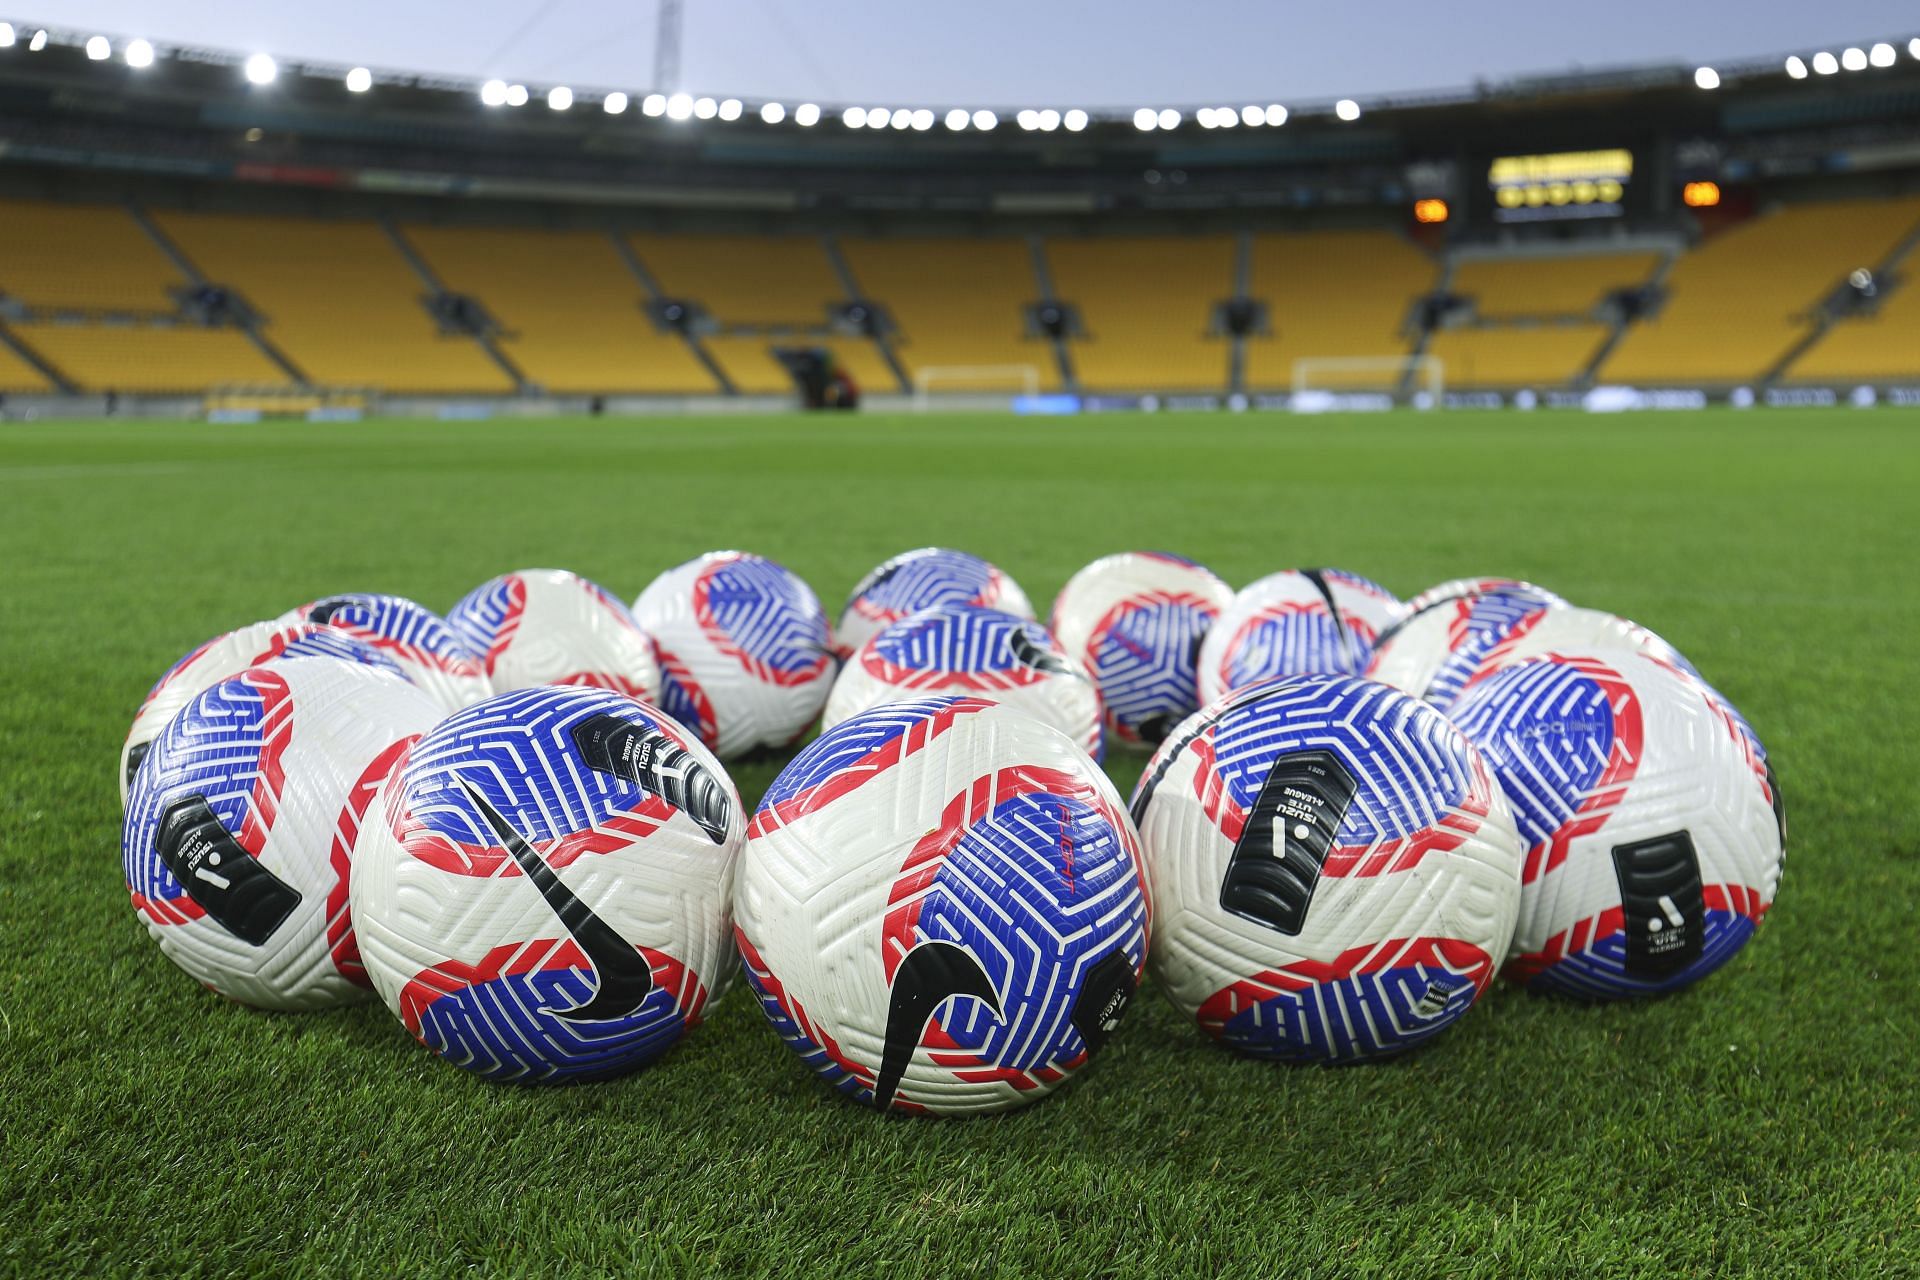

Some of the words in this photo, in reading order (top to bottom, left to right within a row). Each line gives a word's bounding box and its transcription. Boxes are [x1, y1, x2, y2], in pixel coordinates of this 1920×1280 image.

[621, 733, 635, 762] A-LEAGUE
[632, 743, 642, 760] UTE
[638, 742, 652, 770] ISUZU
[1283, 787, 1325, 807] A-LEAGUE
[1287, 798, 1312, 813] UTE
[1276, 803, 1317, 825] ISUZU
[177, 828, 202, 859] A-LEAGUE
[186, 841, 203, 860] UTE
[187, 840, 214, 871] ISUZU
[1056, 802, 1075, 895] FLIGHT
